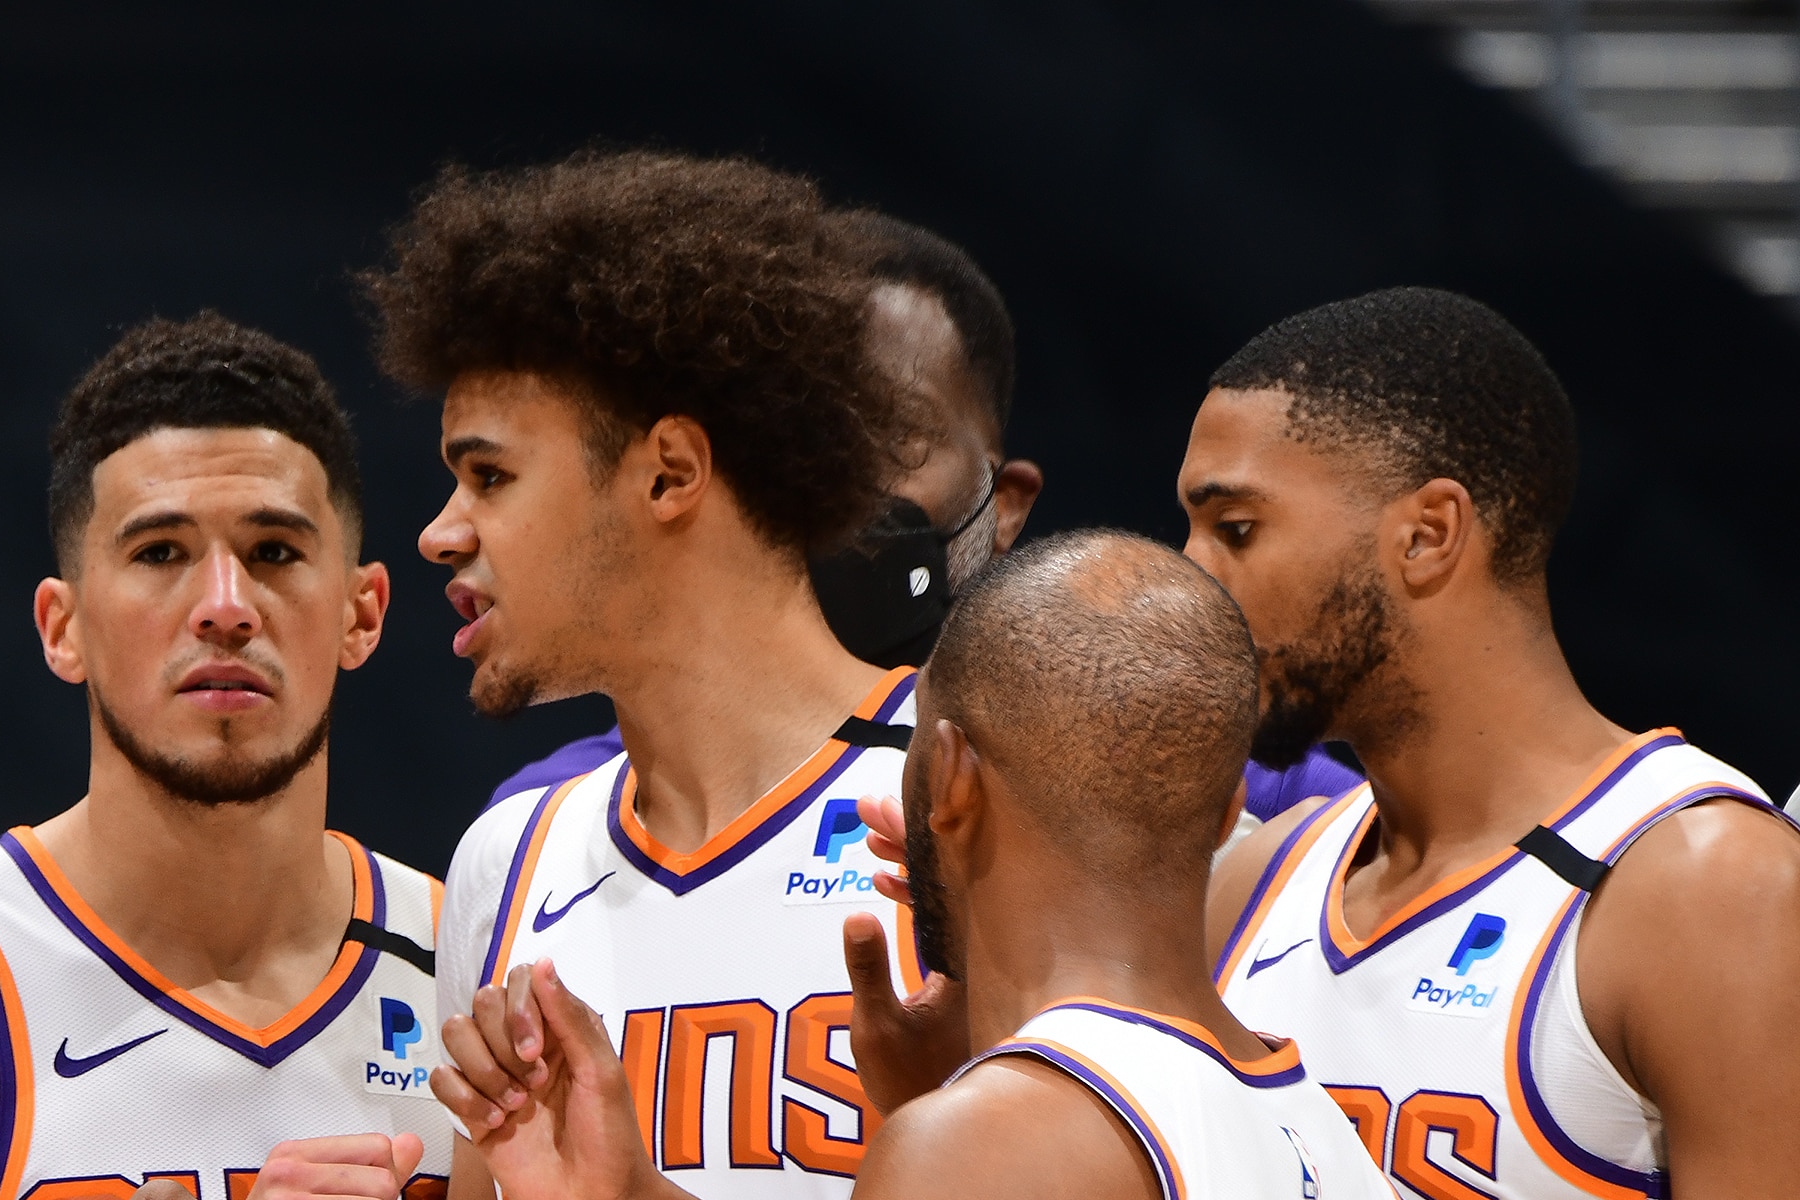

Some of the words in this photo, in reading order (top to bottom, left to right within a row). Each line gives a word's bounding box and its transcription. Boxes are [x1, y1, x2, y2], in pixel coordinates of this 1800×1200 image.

[786, 870, 874, 899] PayPa
[1411, 977, 1499, 1009] PayPal
[366, 1061, 429, 1091] PayP
